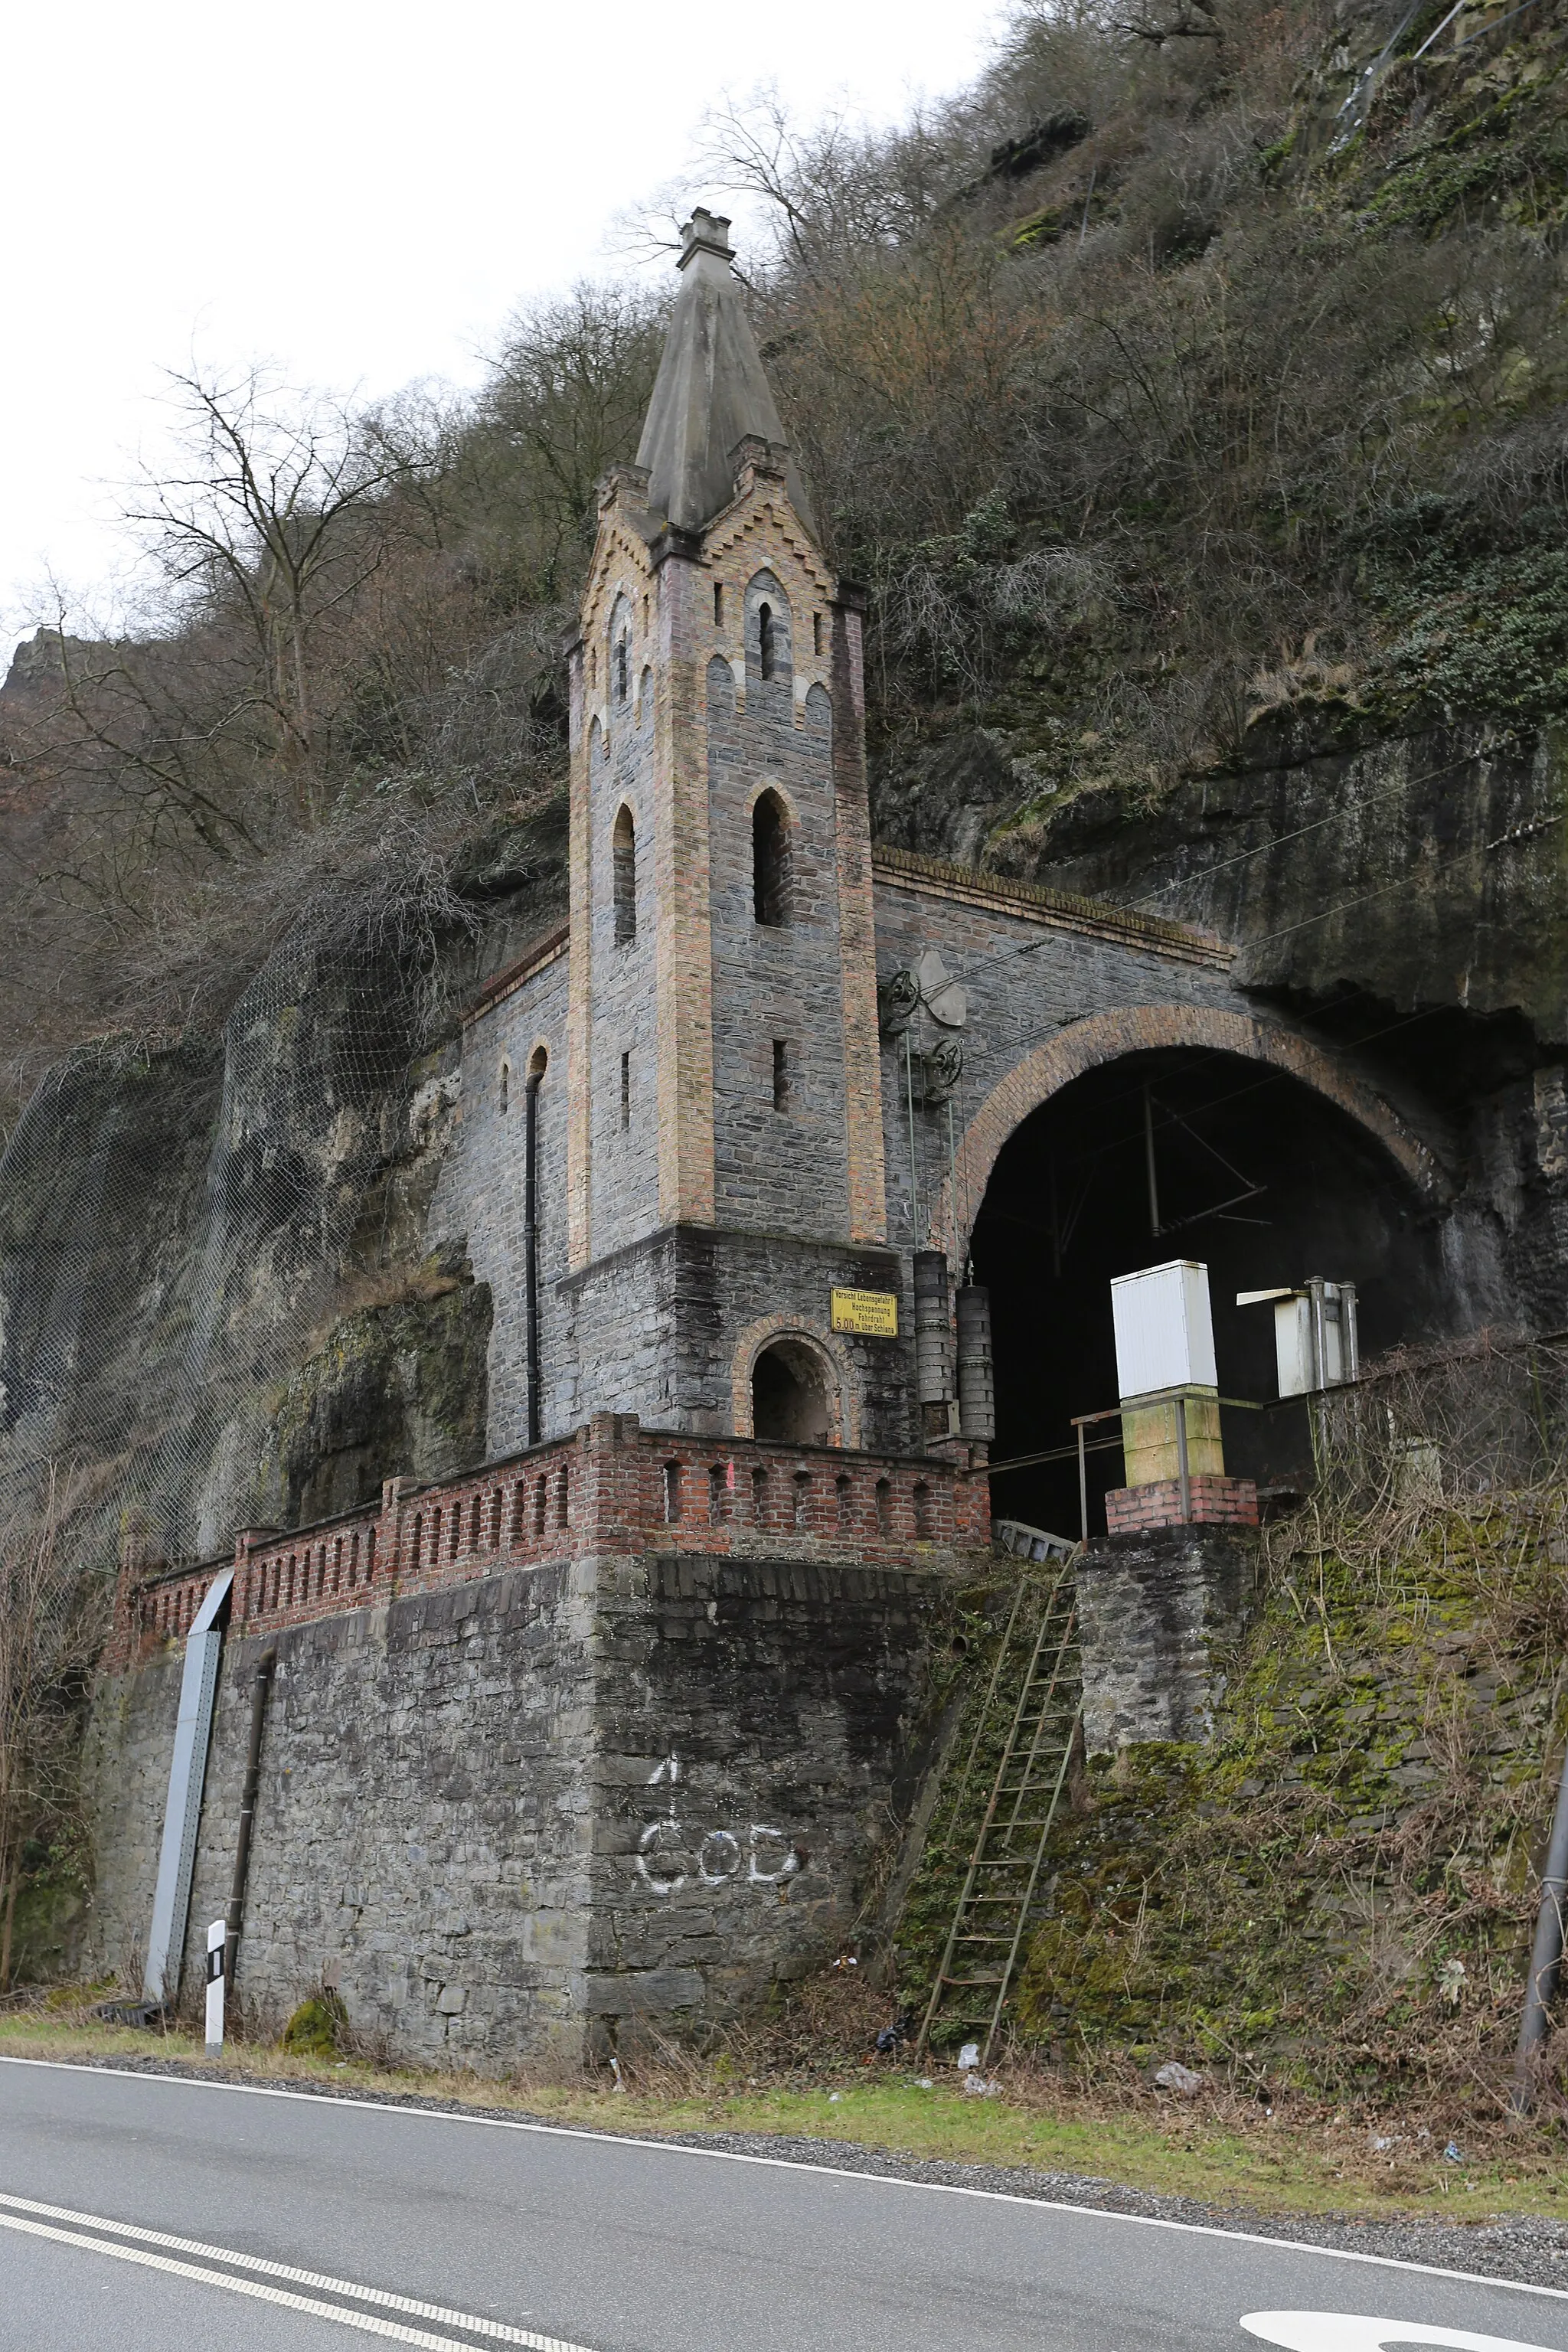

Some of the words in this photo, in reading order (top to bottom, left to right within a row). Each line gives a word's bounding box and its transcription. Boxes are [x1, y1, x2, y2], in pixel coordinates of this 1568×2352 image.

[835, 1290, 856, 1300] Vorsicht
[858, 1293, 893, 1305] Lebensgefahr!
[852, 1302, 890, 1317] Hochspannung
[858, 1313, 885, 1324] Fahrdraht
[861, 1323, 874, 1331] über
[874, 1324, 894, 1334] Schiene
